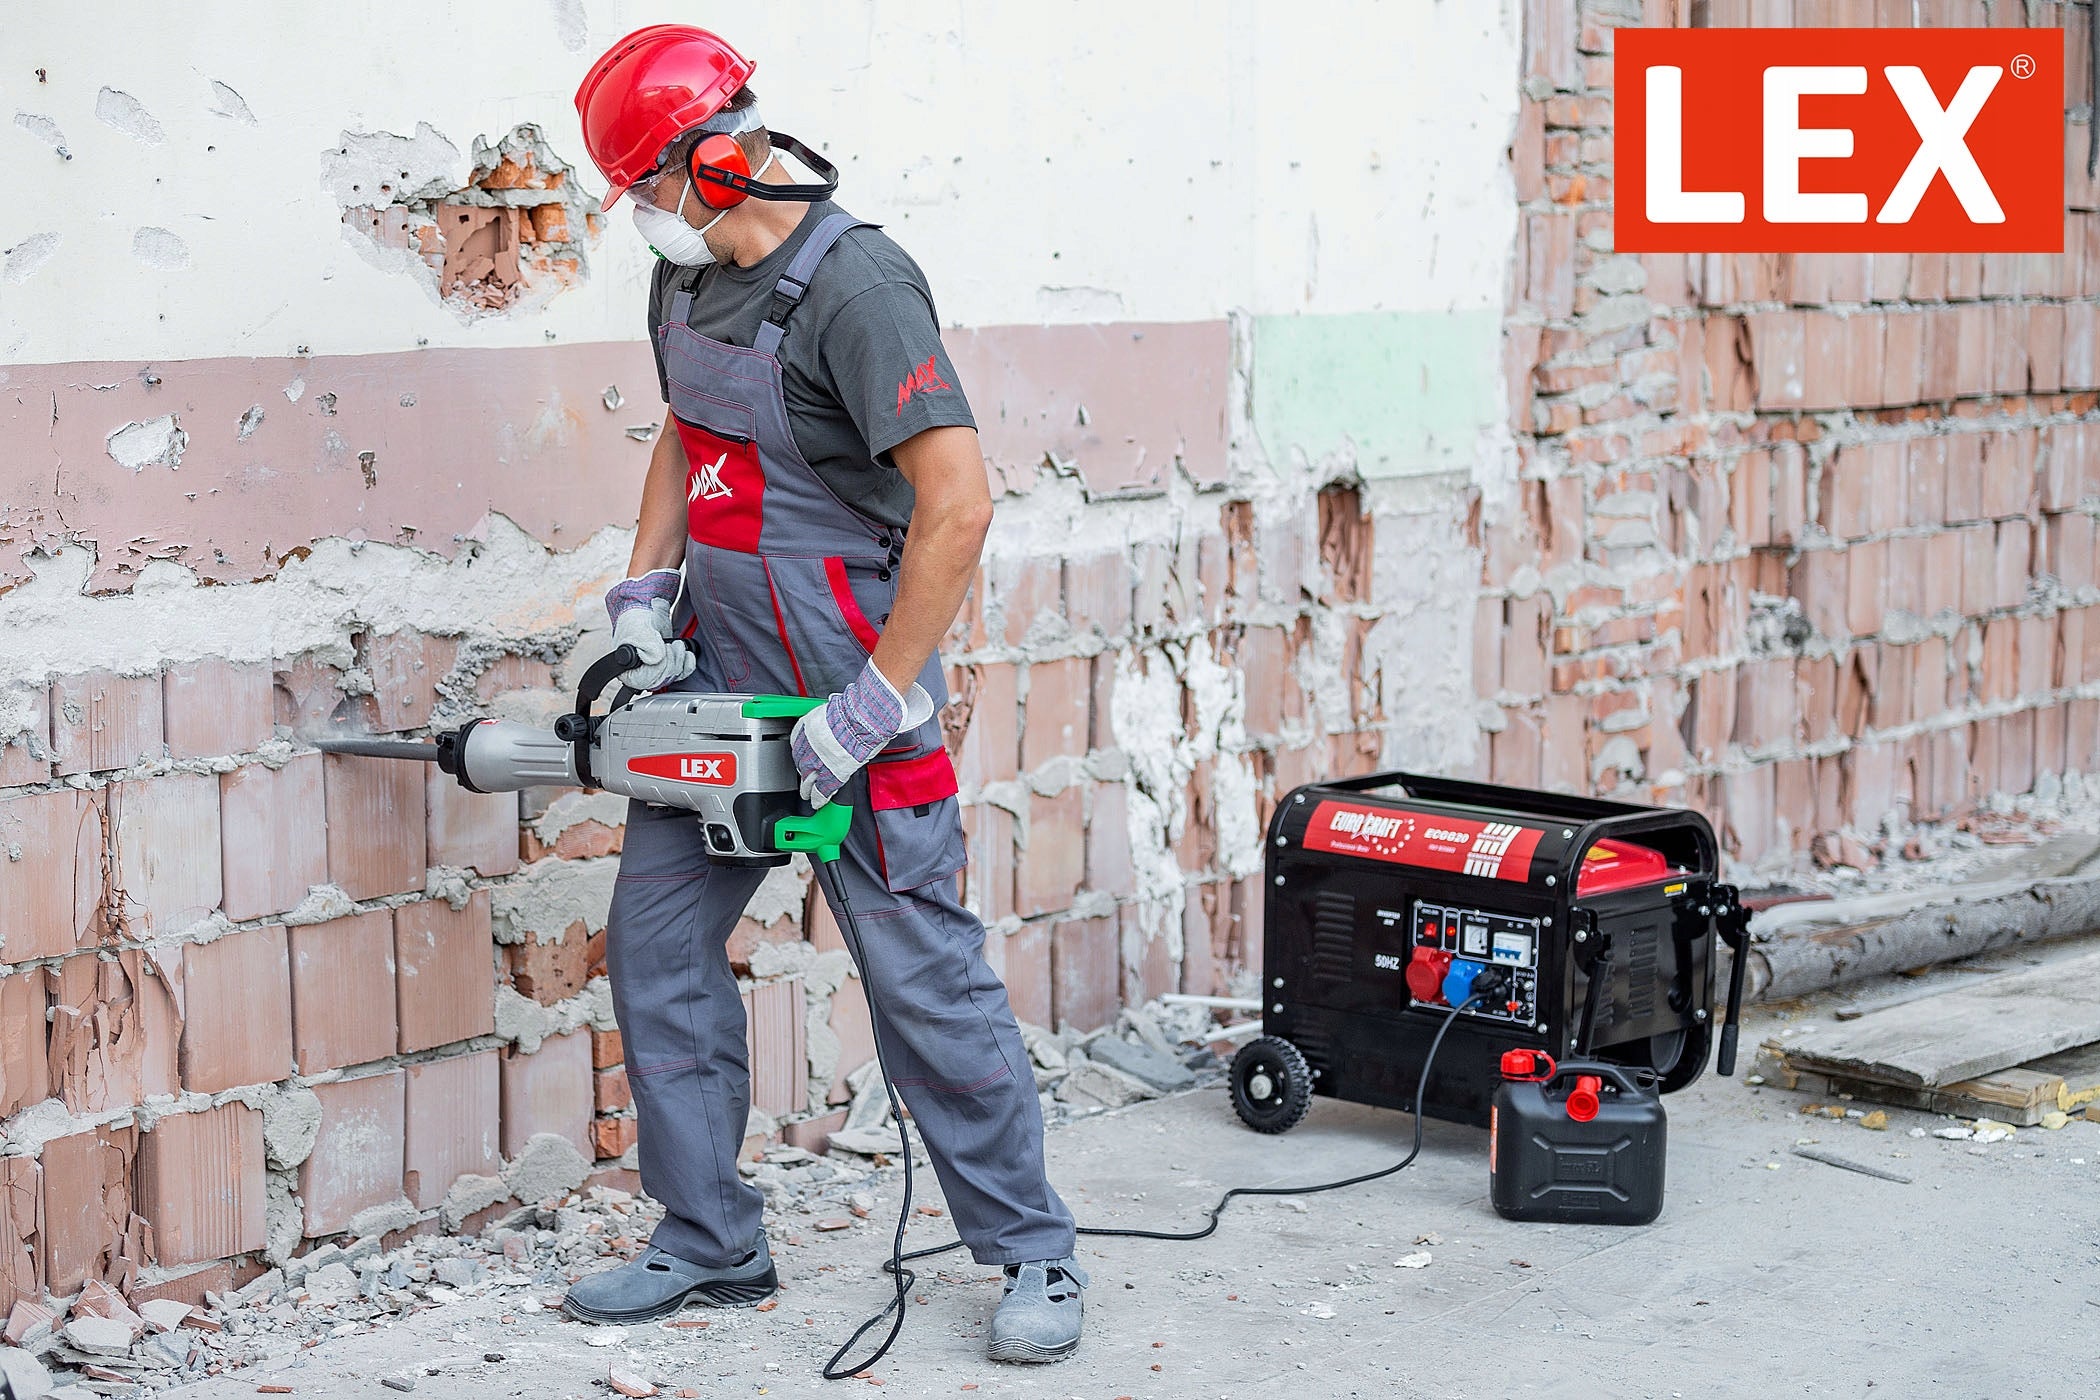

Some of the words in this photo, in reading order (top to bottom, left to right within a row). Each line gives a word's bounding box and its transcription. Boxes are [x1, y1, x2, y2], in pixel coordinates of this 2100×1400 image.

[896, 354, 952, 418] MAX
[687, 452, 733, 506] MAX
[681, 759, 723, 779] LEX
